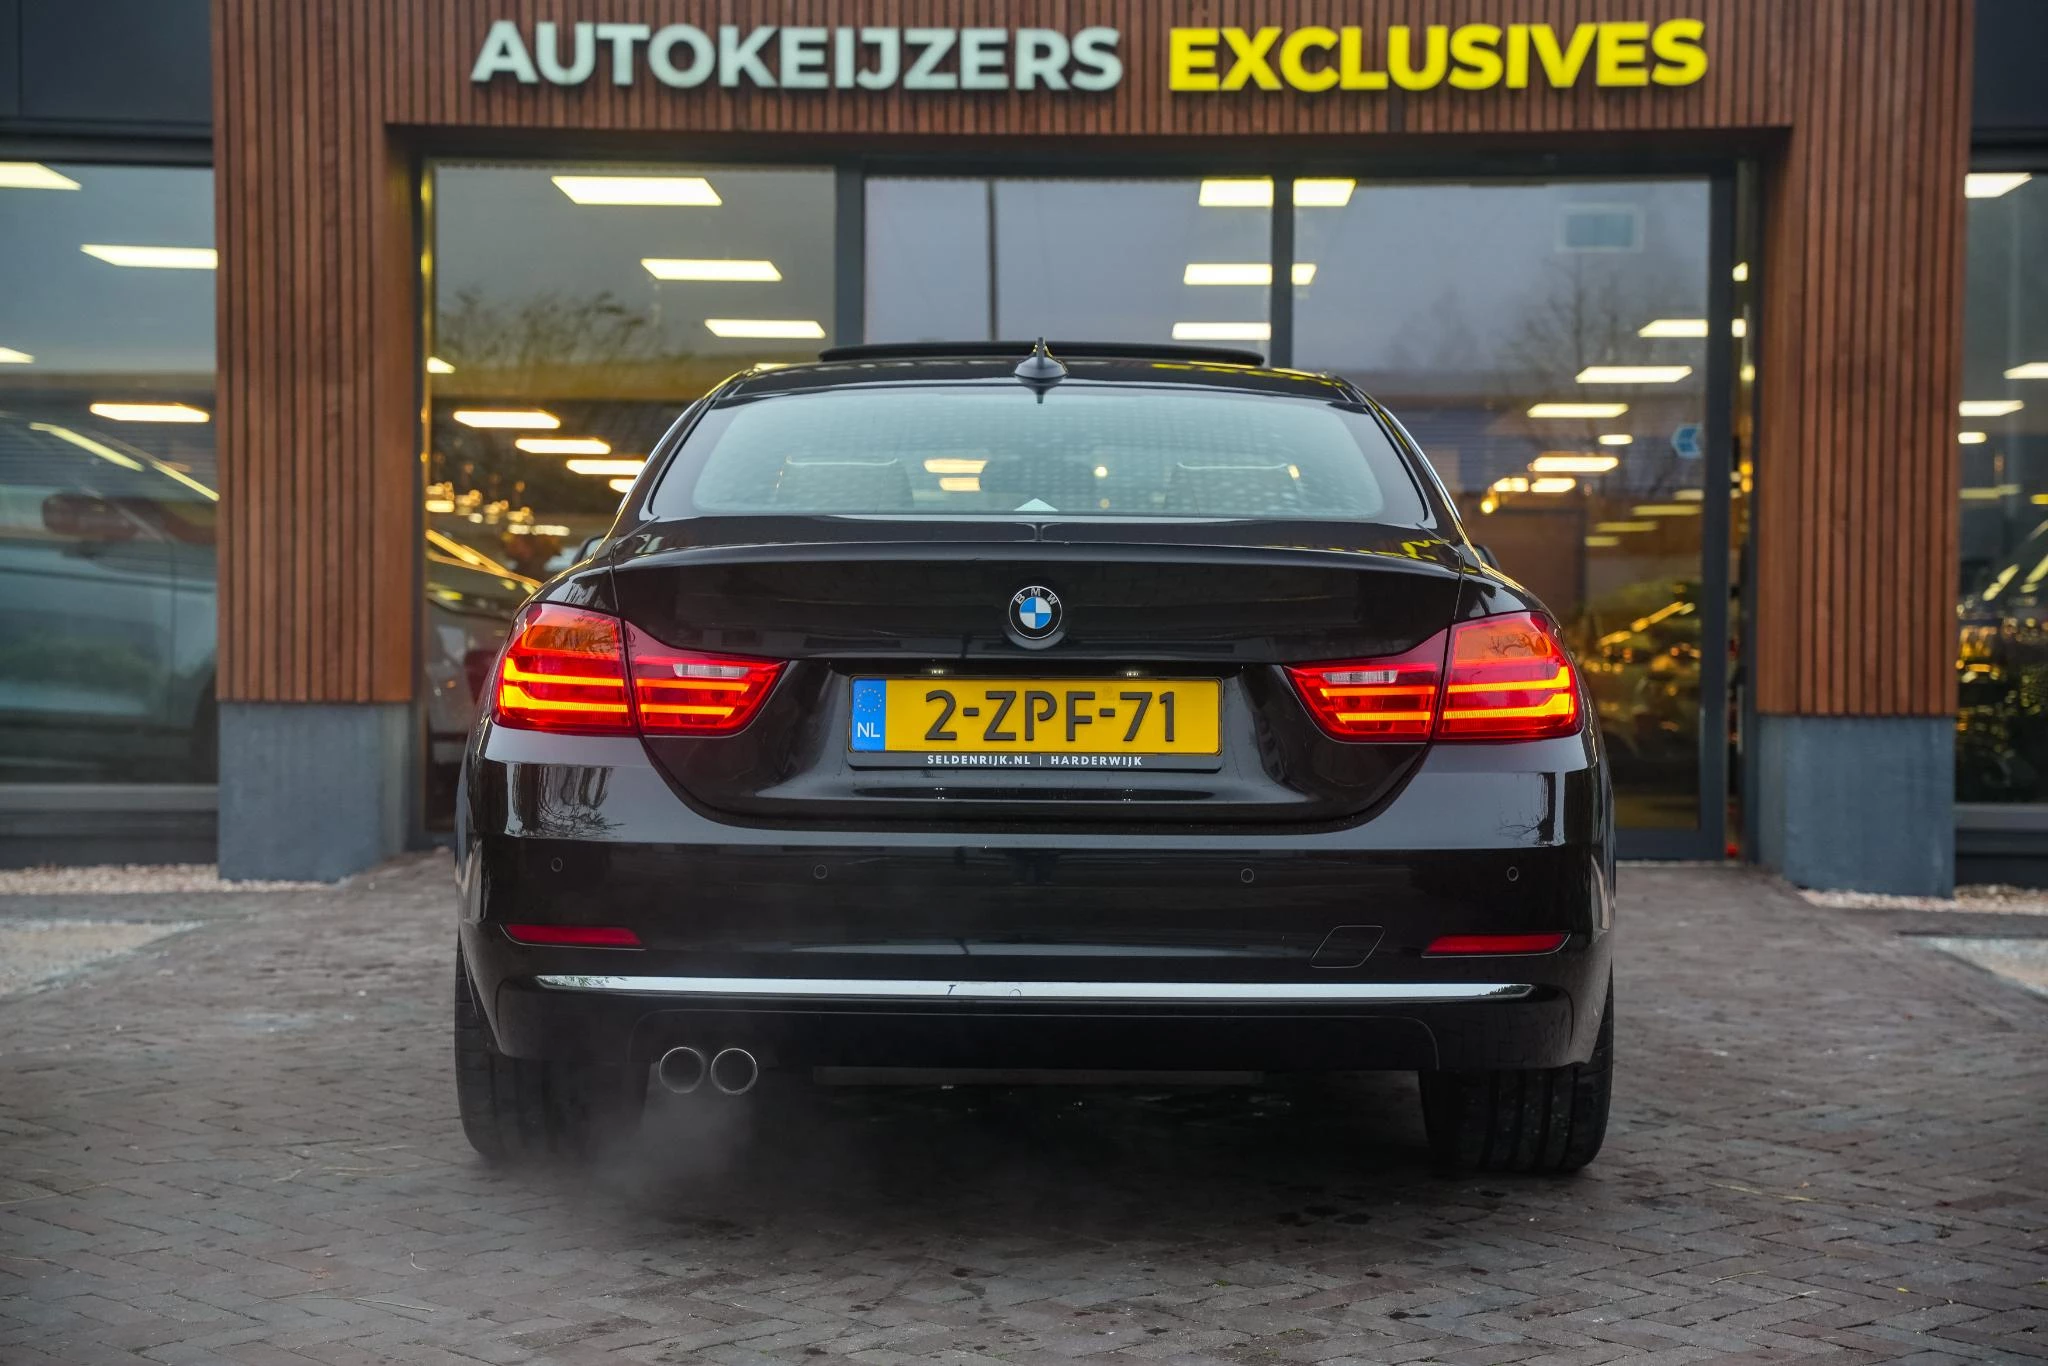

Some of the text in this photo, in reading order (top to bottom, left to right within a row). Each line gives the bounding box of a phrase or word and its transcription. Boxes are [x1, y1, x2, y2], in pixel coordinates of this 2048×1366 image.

[471, 18, 1708, 93] AUTOKEIJZERS EXCLUSIVES
[1015, 586, 1058, 605] BMW
[924, 690, 1175, 742] 2-ZPF-71
[857, 722, 880, 738] NL
[927, 754, 1142, 766] SELDENRIJK.NL HARDERWIJK
